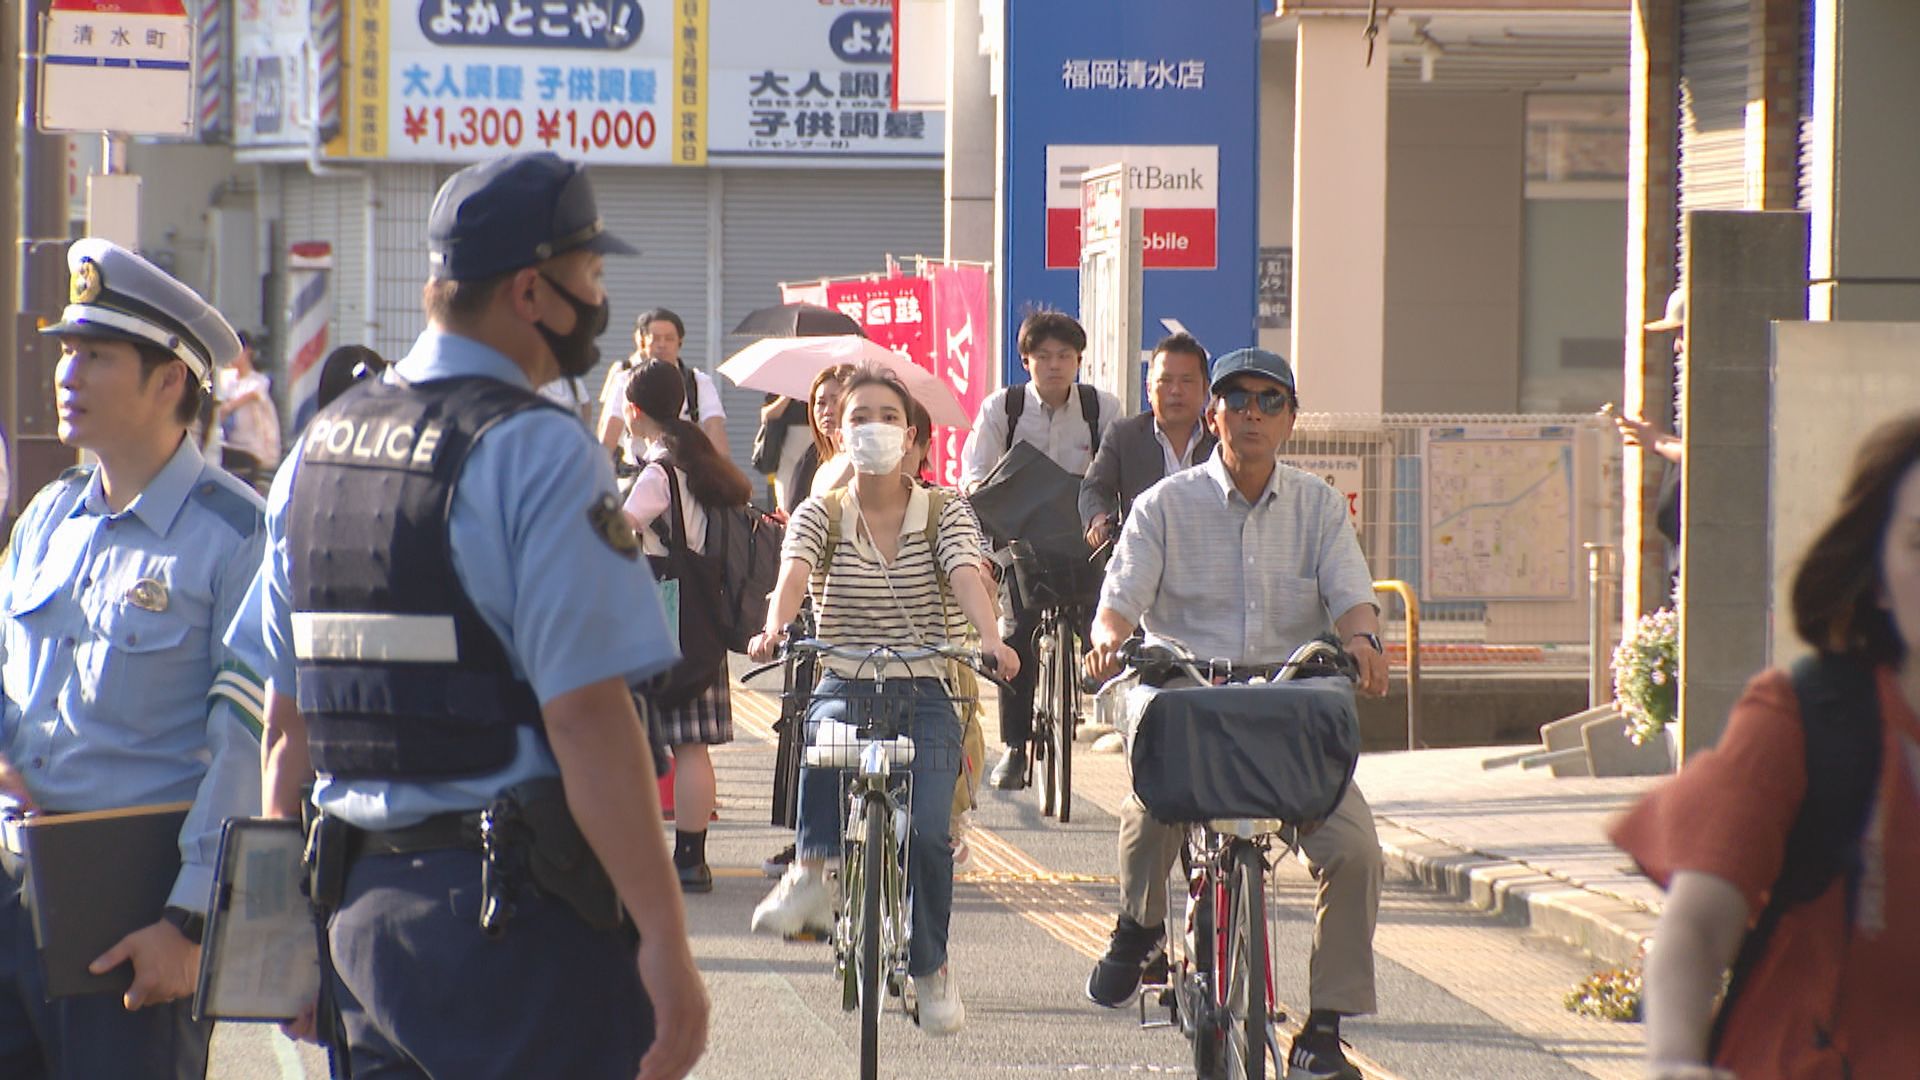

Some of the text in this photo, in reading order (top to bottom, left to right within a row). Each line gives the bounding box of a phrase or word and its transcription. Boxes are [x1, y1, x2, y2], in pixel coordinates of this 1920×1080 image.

[430, 0, 630, 38] よかとこや!
[73, 23, 167, 48] 清水町
[842, 20, 892, 54] よ
[402, 64, 657, 104] 大人調髪 子供調髪
[750, 70, 892, 98] 大人調
[1062, 59, 1205, 88] 福岡清水店
[403, 106, 657, 152] ¥1,300 ¥1,000
[750, 110, 925, 138] 子供調髪
[1129, 165, 1204, 190] ftBank
[1142, 232, 1189, 250] obile
[305, 420, 442, 462] POLICE
